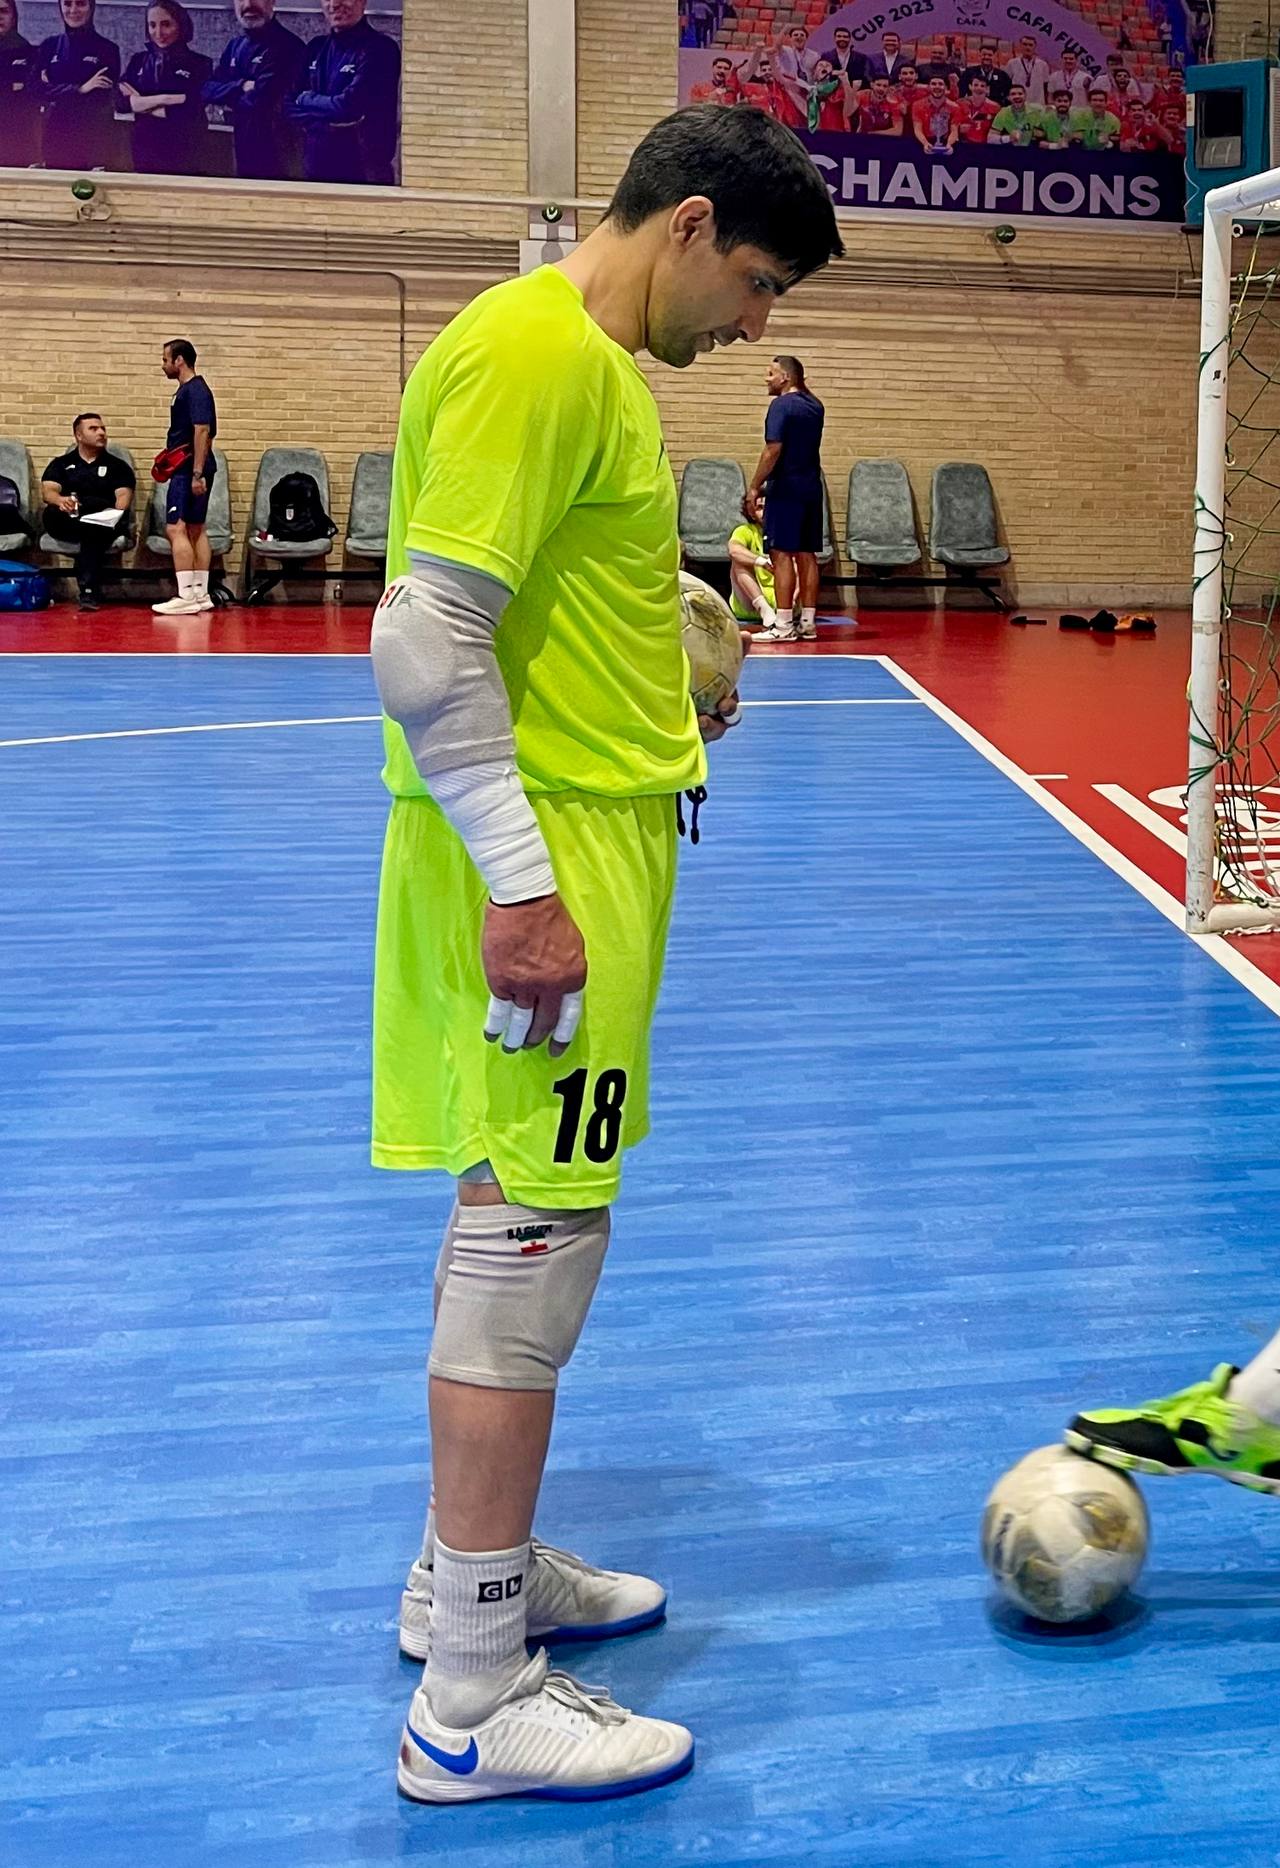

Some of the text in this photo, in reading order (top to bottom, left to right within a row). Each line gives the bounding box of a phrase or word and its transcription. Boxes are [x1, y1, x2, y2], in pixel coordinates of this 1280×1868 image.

[852, 0, 934, 41] CUP 2023
[957, 17, 986, 27] CAFA
[1007, 6, 1104, 79] CAFA FUTSA
[552, 1068, 627, 1163] 18
